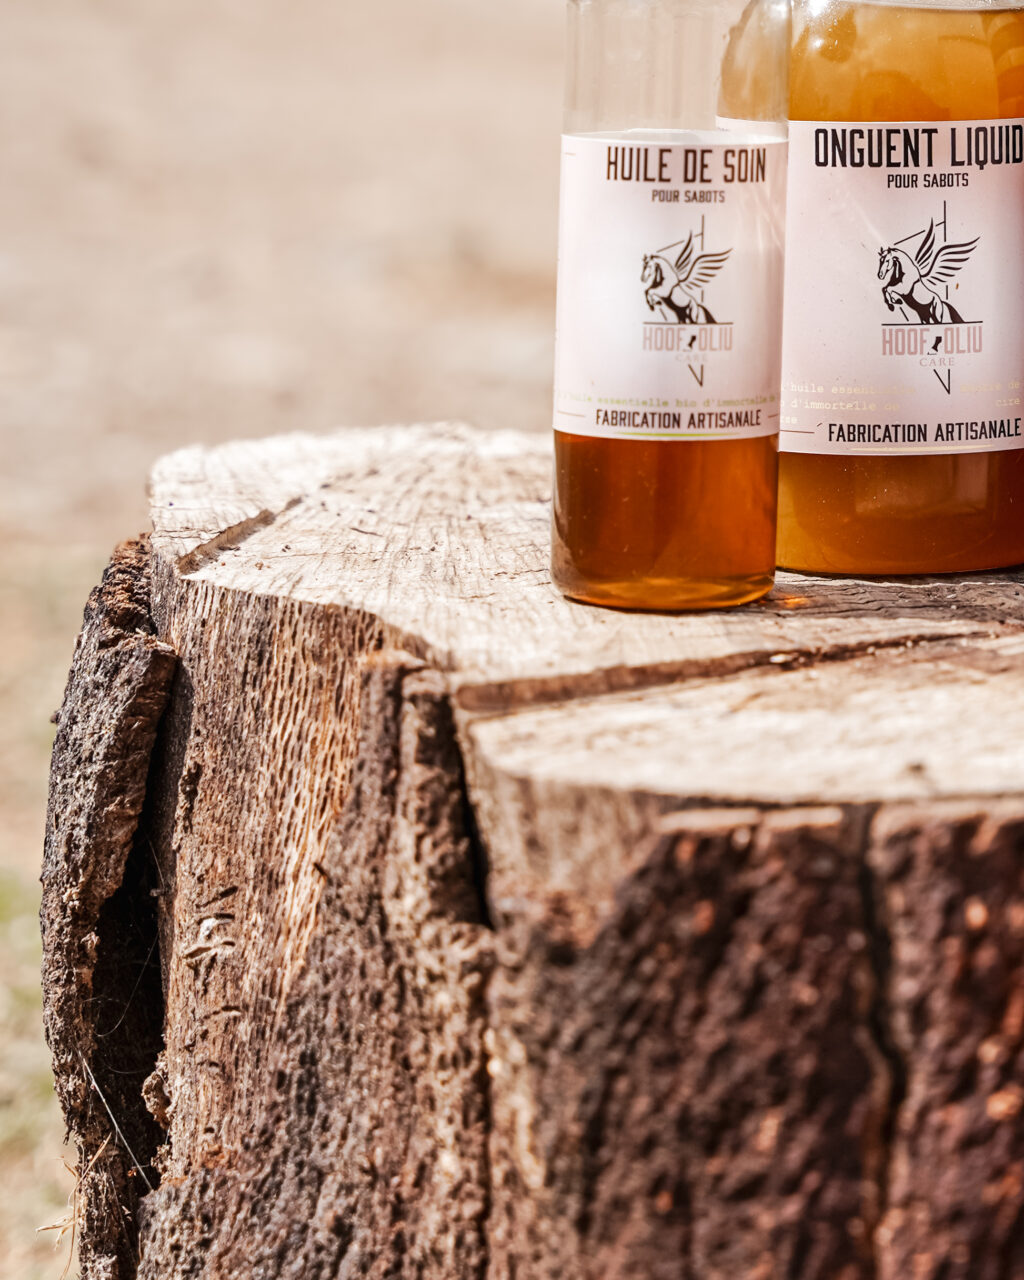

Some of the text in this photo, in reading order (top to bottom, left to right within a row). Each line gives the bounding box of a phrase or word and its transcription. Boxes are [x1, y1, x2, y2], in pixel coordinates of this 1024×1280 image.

[814, 128, 939, 169] ONGUENT
[606, 146, 767, 184] HUILE DE SOIN
[886, 172, 970, 189] POUR SABOTS
[651, 189, 726, 204] POUR SABOTS
[642, 326, 684, 352] HOOF
[881, 327, 931, 357] HOOF
[918, 356, 957, 368] CARE
[595, 409, 762, 429] FABRICATION ARTISANALE
[827, 418, 1023, 443] FABRICATION ARTISANALE
